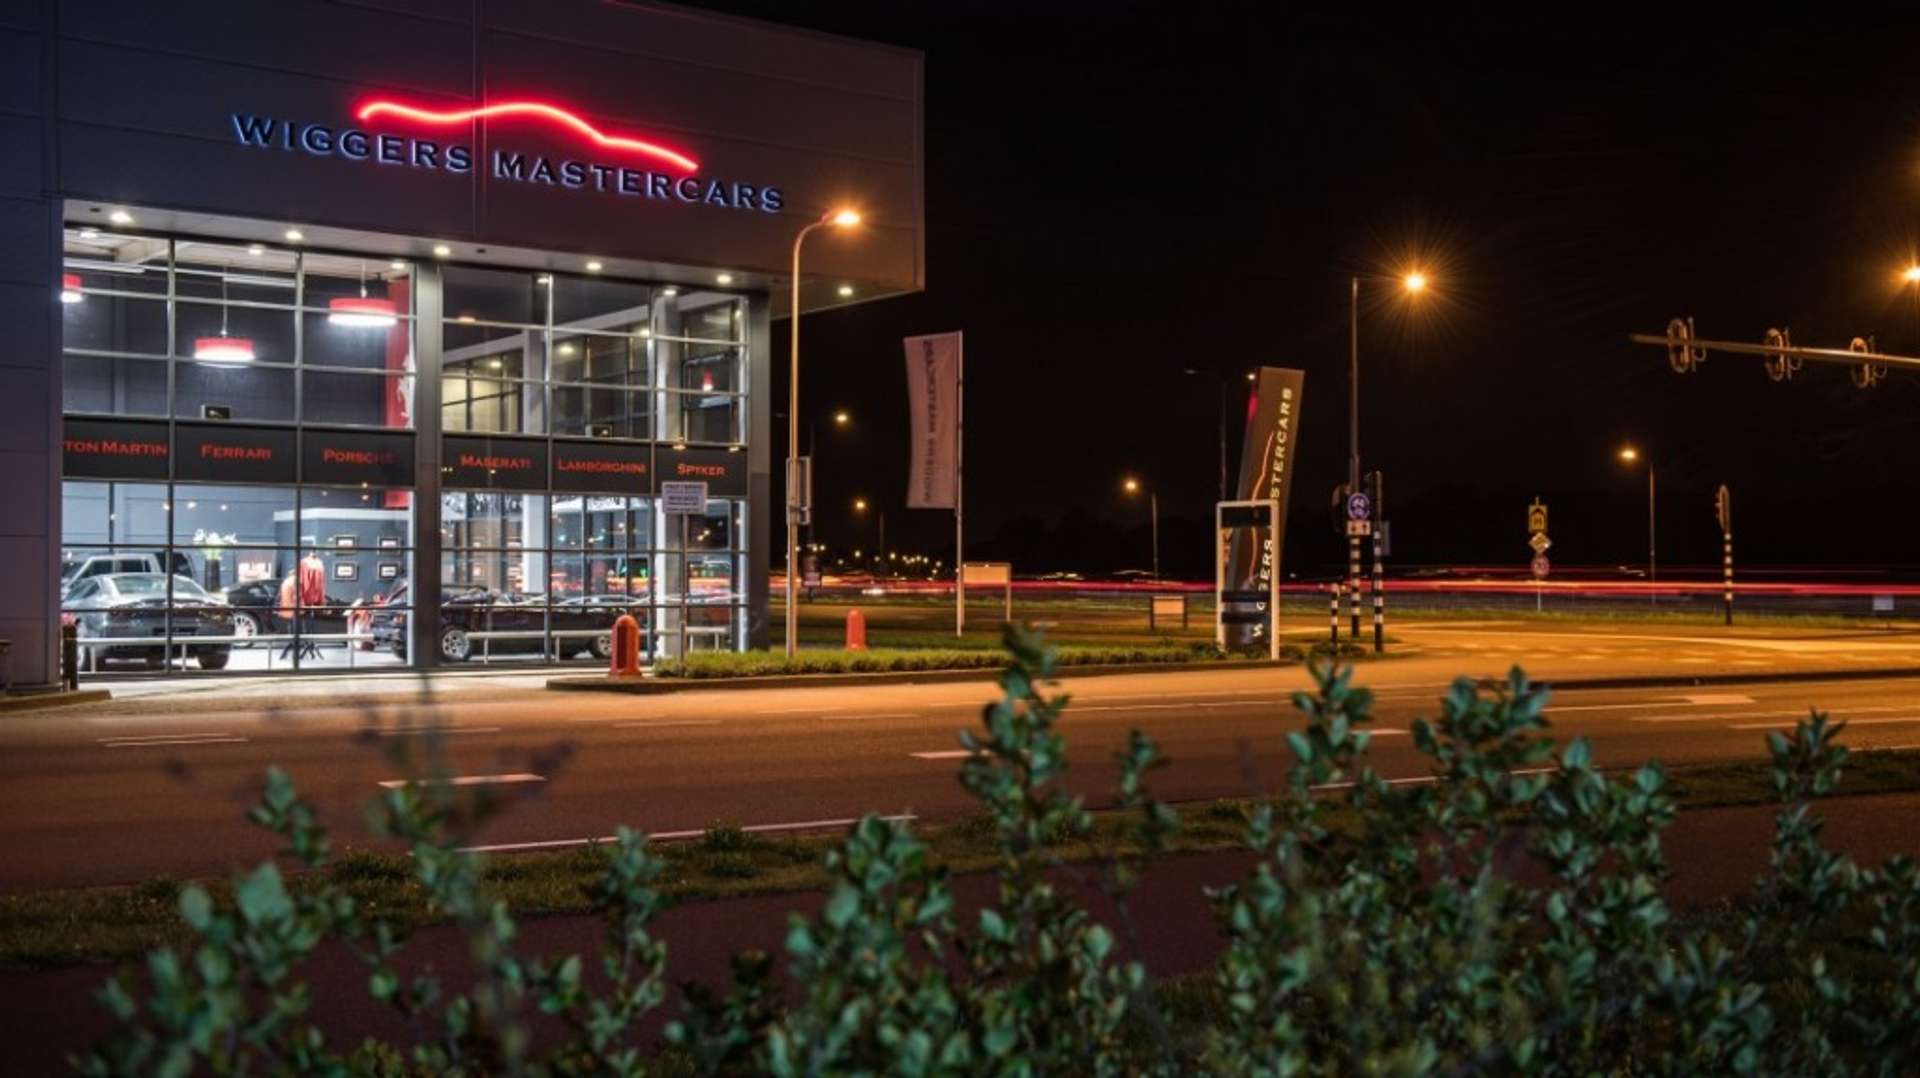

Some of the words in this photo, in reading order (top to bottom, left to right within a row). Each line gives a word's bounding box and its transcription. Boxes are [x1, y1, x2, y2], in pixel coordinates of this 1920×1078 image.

[232, 112, 473, 173] WIGGERS
[492, 150, 785, 213] MASTERCARS
[102, 439, 168, 457] MARTIN
[1270, 387, 1293, 498] STERCARS
[201, 443, 272, 460] FERRARI
[460, 455, 532, 470] MASERATI
[557, 459, 647, 475] LAMBORGHINI
[676, 463, 727, 476] SPYKER
